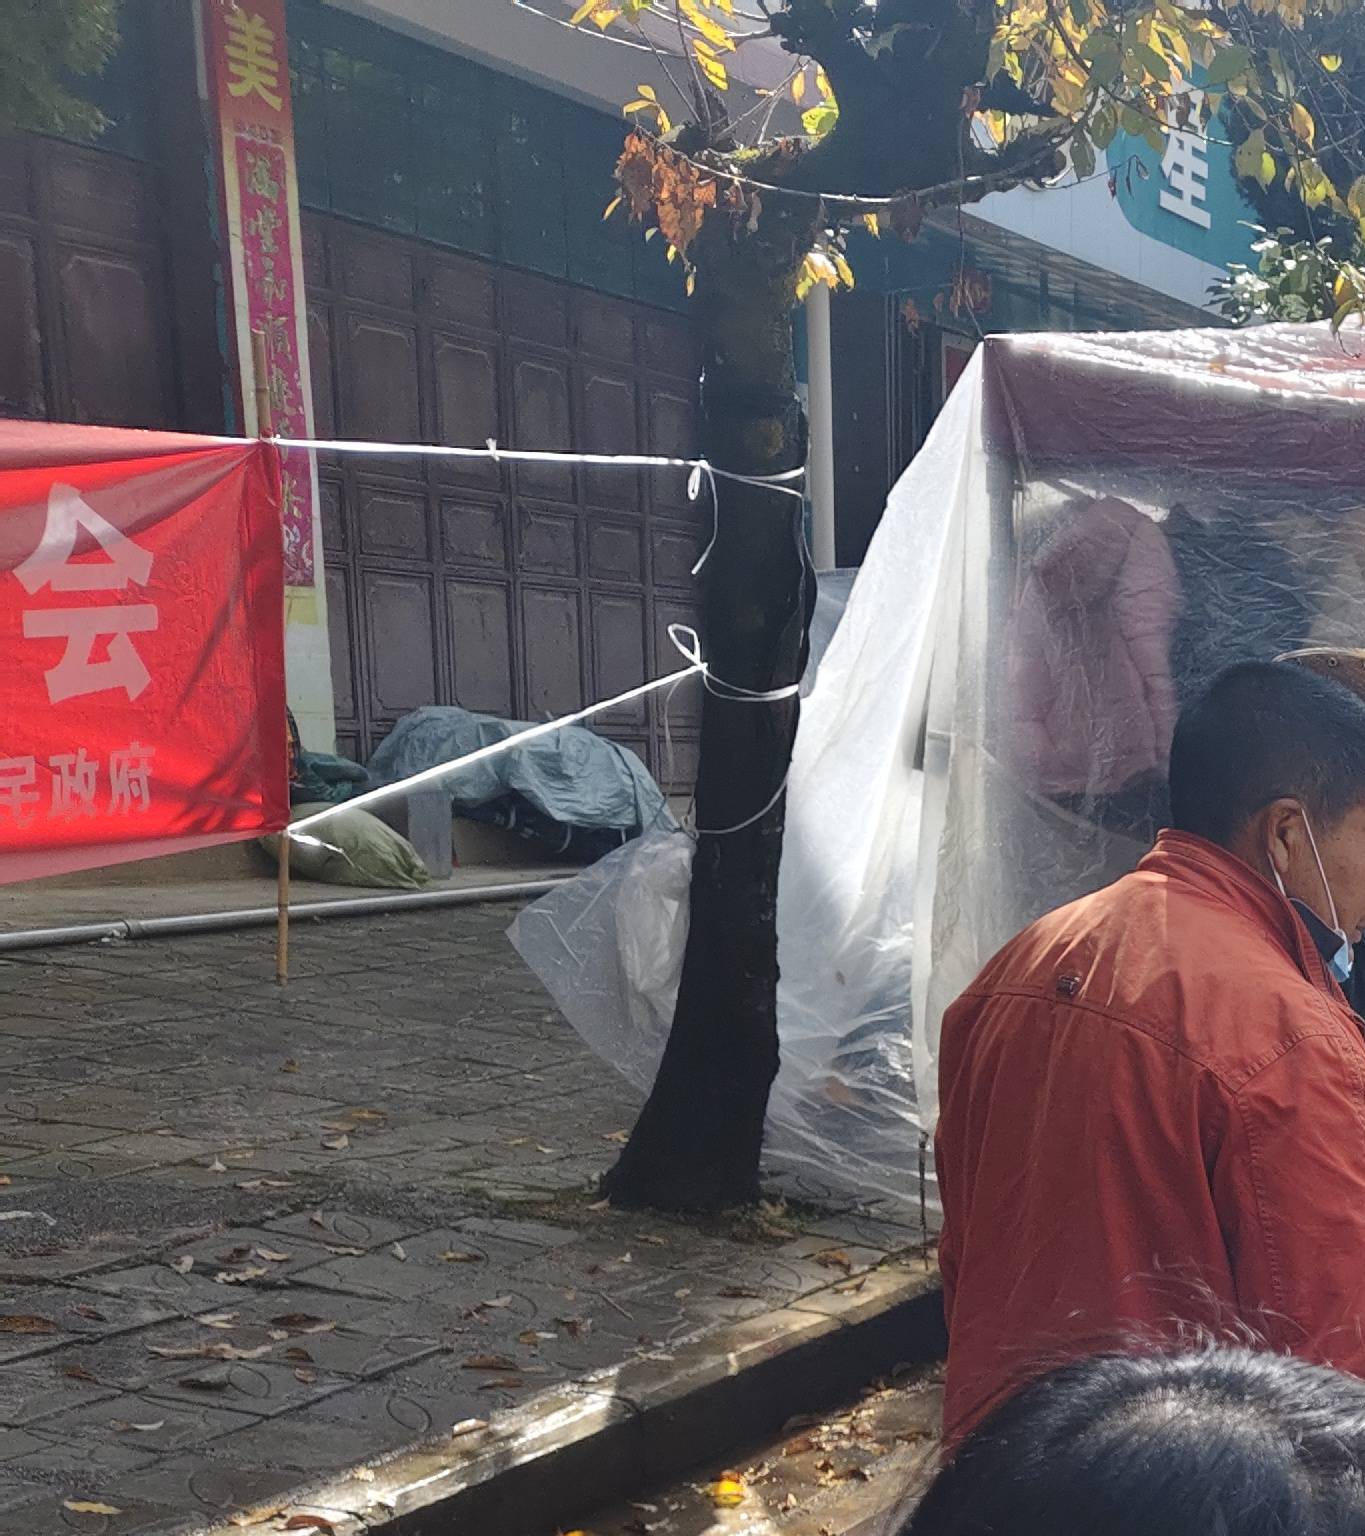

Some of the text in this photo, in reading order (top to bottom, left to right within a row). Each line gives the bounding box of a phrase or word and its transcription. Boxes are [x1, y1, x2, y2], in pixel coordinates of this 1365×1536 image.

[223, 8, 282, 112] 美
[14, 483, 158, 704] 会
[0, 740, 156, 829] 民政府
